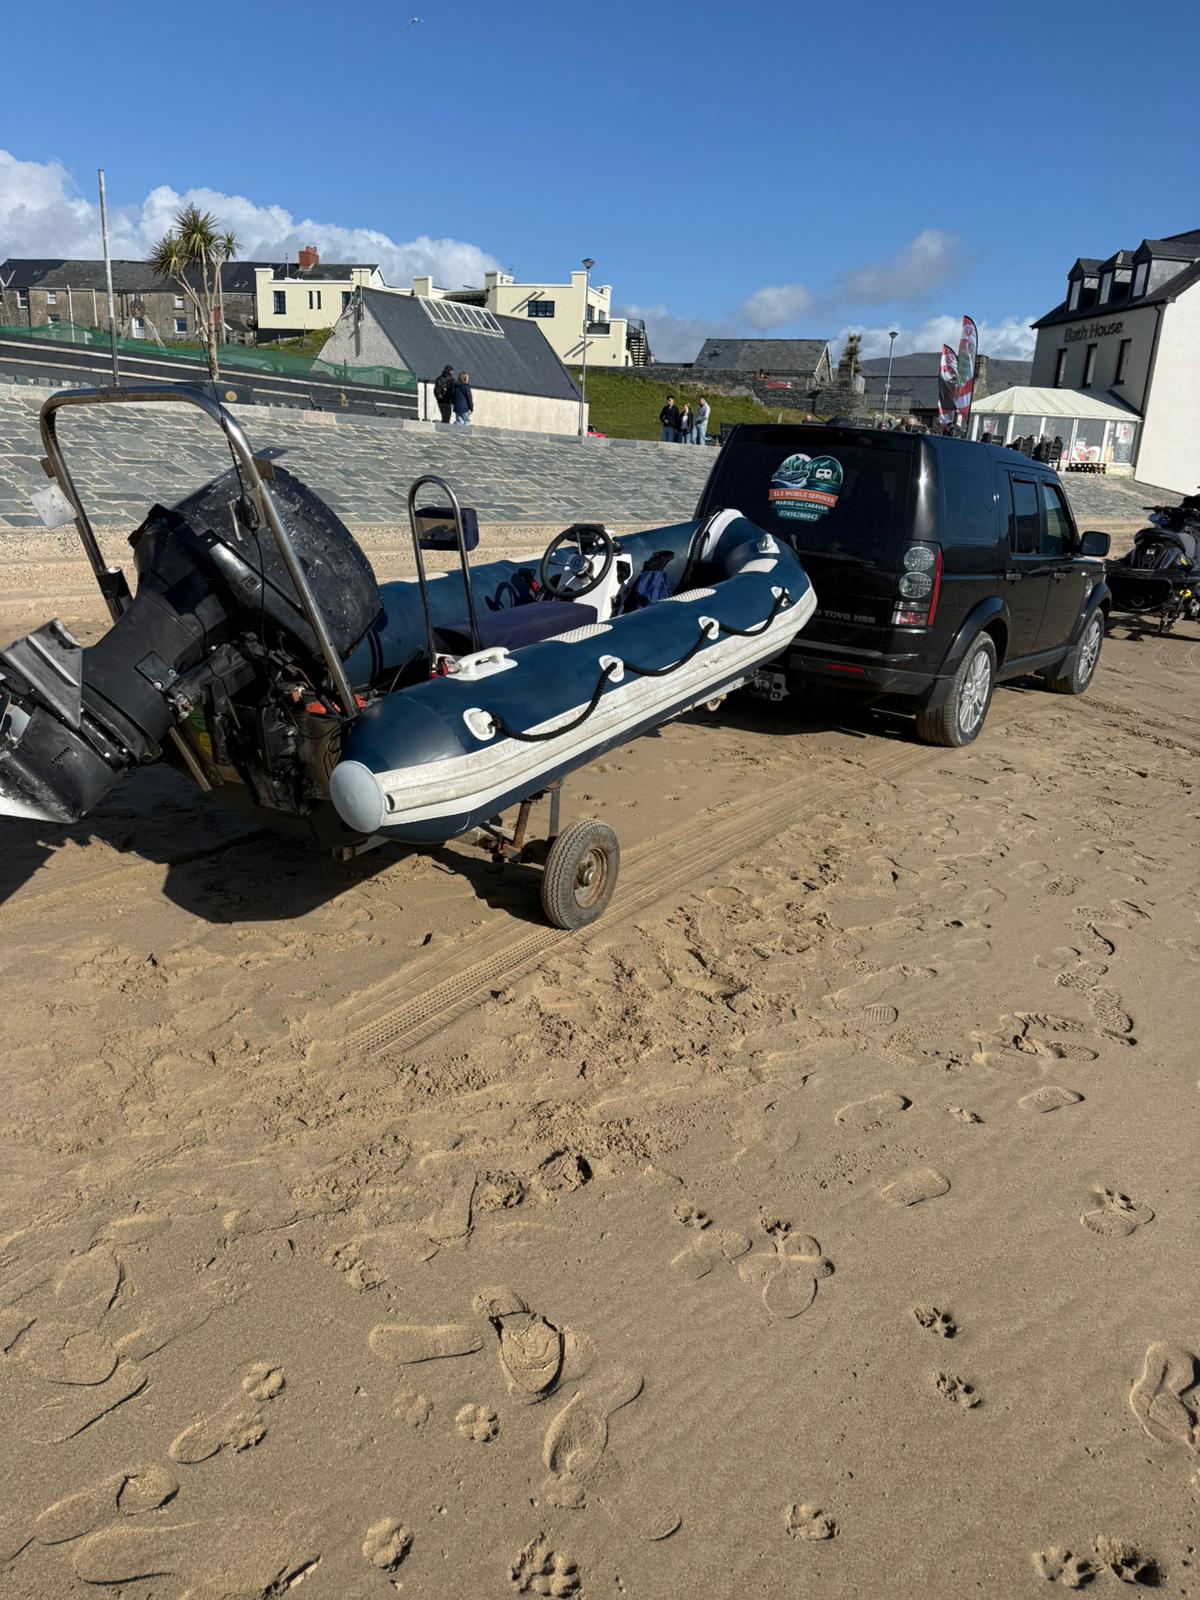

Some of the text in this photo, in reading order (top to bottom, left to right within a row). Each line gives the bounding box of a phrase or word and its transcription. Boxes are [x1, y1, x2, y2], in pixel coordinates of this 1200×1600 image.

[1064, 320, 1124, 343] Bath House
[807, 493, 834, 502] SERVICES
[804, 502, 828, 510] CARAVAN
